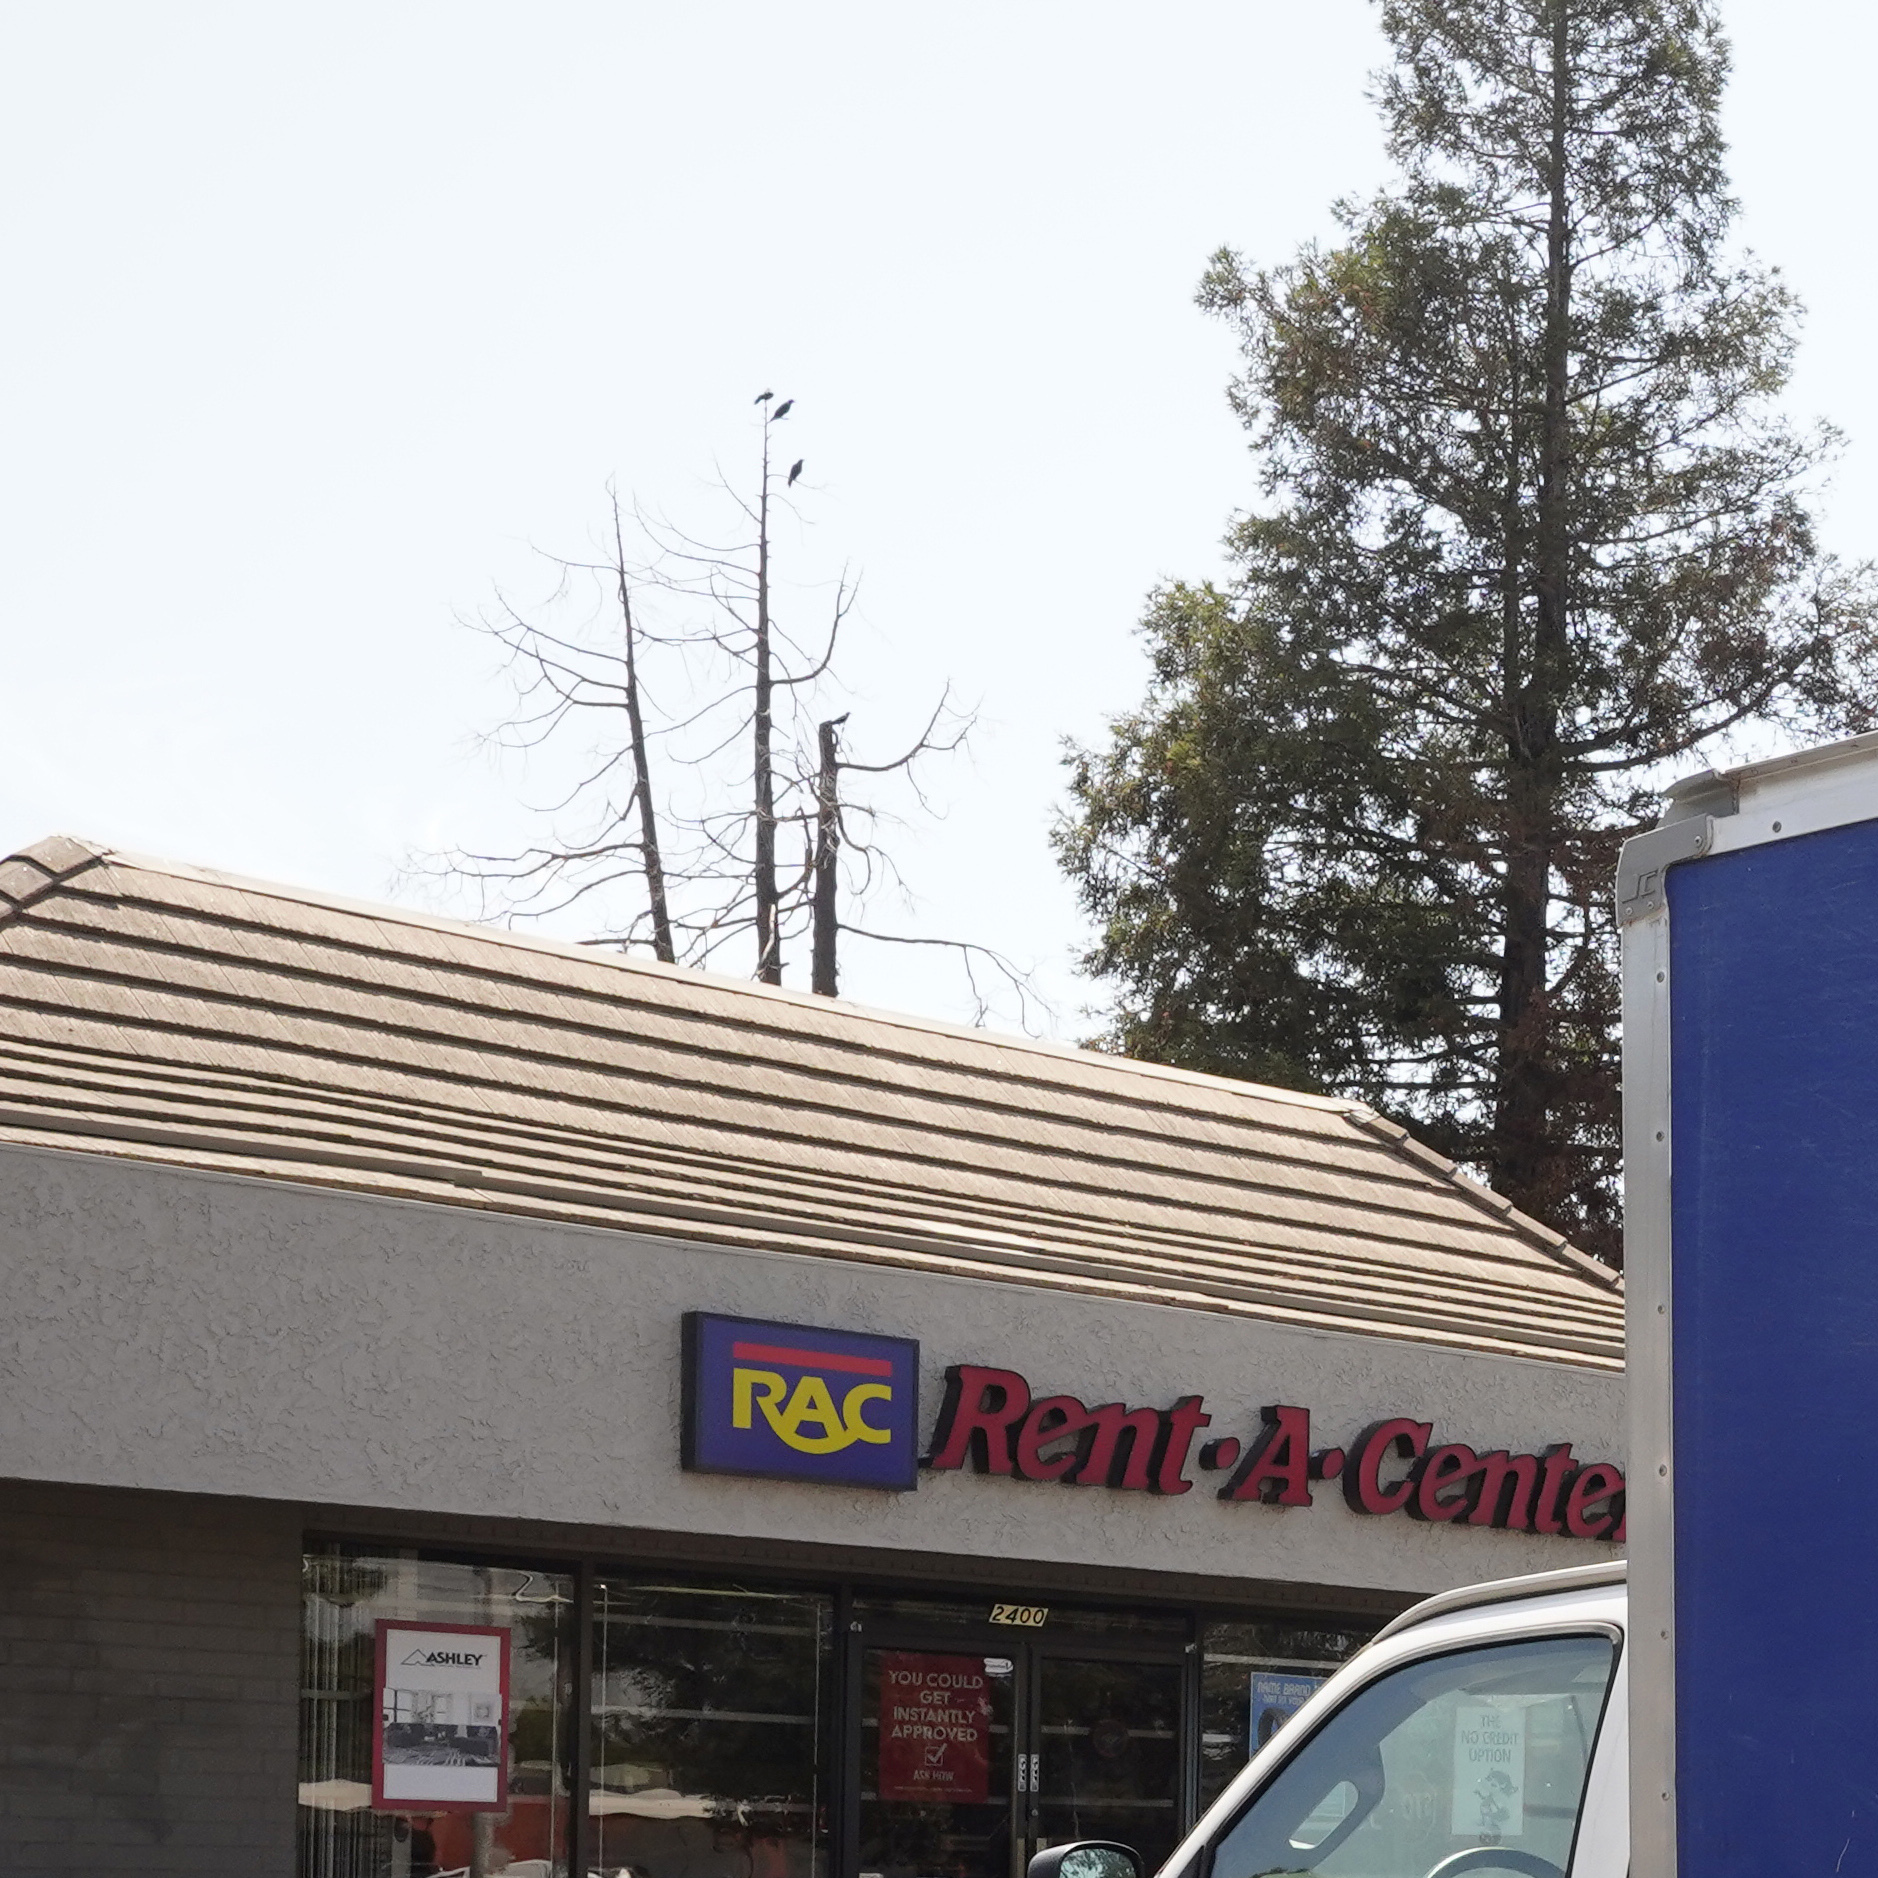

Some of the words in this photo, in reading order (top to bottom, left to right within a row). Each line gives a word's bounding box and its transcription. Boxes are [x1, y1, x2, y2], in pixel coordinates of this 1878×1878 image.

[733, 1368, 892, 1454] RAC
[930, 1364, 1626, 1542] Rent·A·Cente
[992, 1606, 1045, 1625] 2400
[426, 1651, 483, 1666] ASHLEY
[889, 1670, 923, 1686] YOU
[927, 1673, 984, 1689] COULD
[920, 1690, 951, 1705] GET
[893, 1705, 976, 1724] INSTANTLY
[891, 1724, 978, 1742] APPROVED
[1461, 1730, 1479, 1744] NO
[1483, 1732, 1519, 1746] CREDIT
[1468, 1749, 1512, 1764] OPTION
